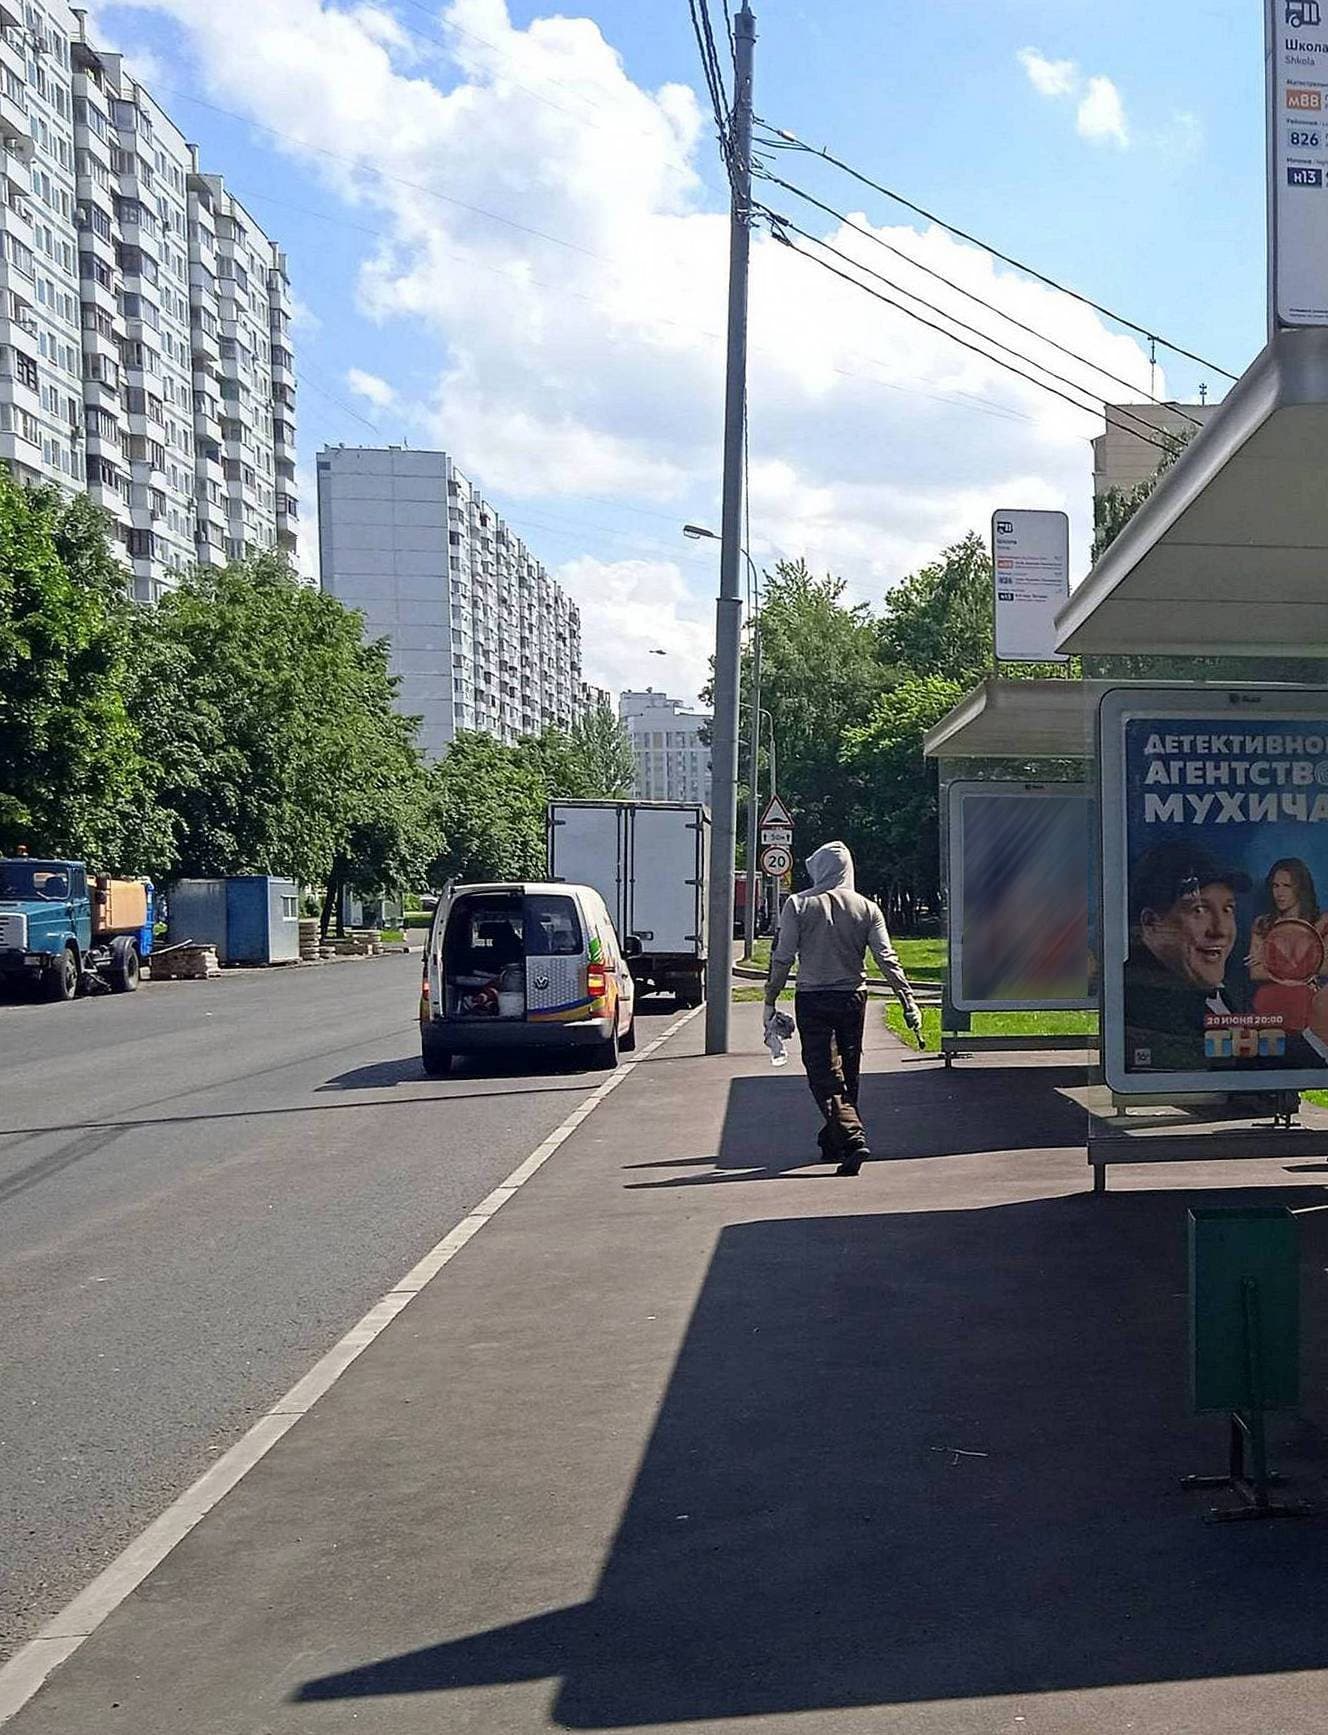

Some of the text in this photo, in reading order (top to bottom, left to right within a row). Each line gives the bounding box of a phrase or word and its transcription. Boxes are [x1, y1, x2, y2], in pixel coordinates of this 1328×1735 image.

[1285, 39, 1328, 53] Школа
[1285, 55, 1315, 65] Shkola
[1290, 131, 1319, 146] 826
[768, 855, 786, 868] 20
[1221, 1015, 1253, 1025] ИЮНЯ
[1204, 1028, 1287, 1058] ТНТ
